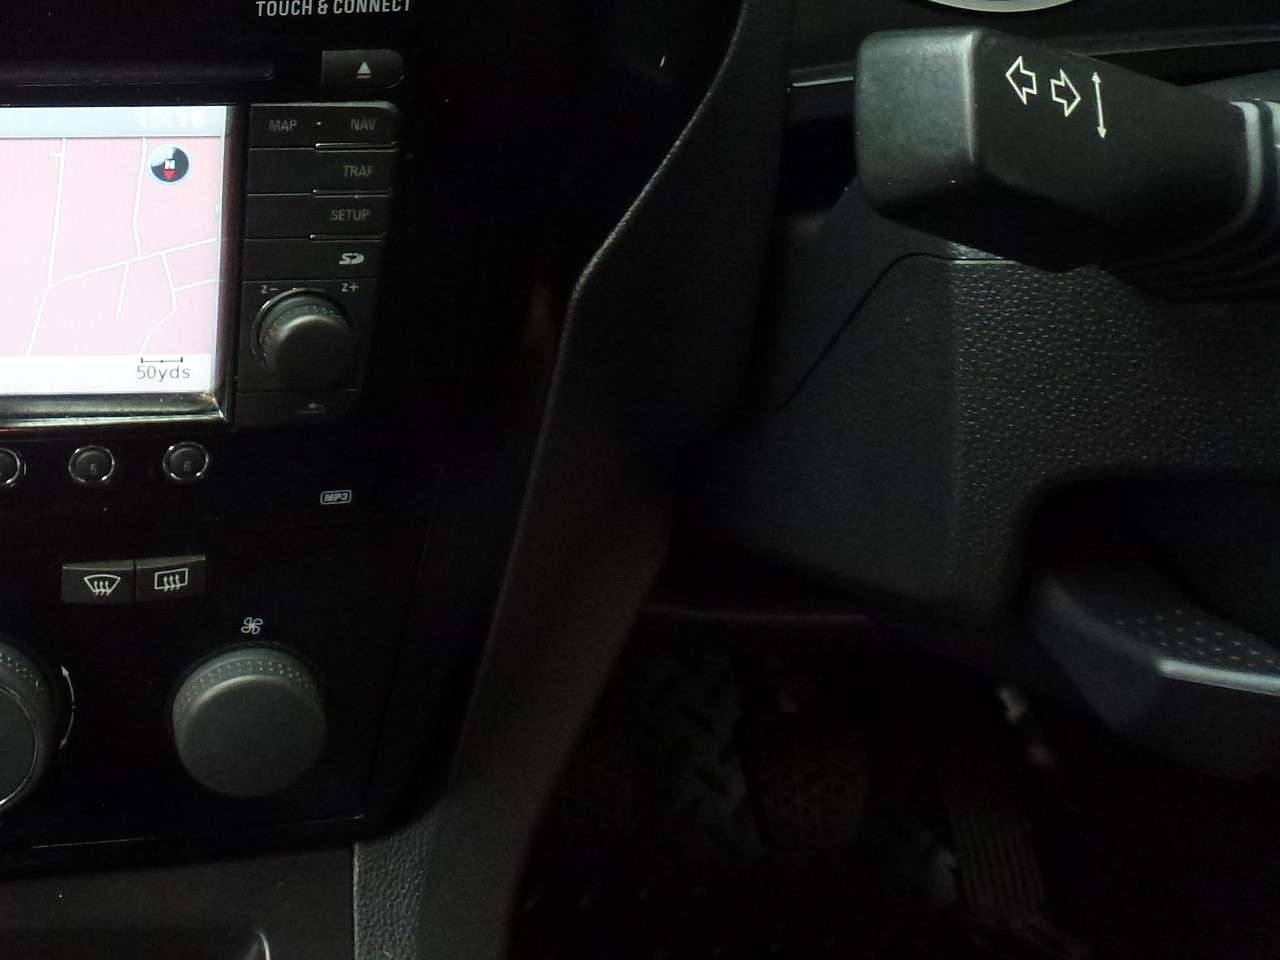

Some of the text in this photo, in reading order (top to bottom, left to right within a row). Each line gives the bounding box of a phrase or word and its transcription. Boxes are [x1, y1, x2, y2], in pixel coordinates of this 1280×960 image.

[255, 0, 314, 17] TOUCH
[269, 119, 298, 133] MAP
[350, 118, 378, 132] NAV
[330, 209, 371, 222] SETUP
[136, 364, 191, 383] 50yds
